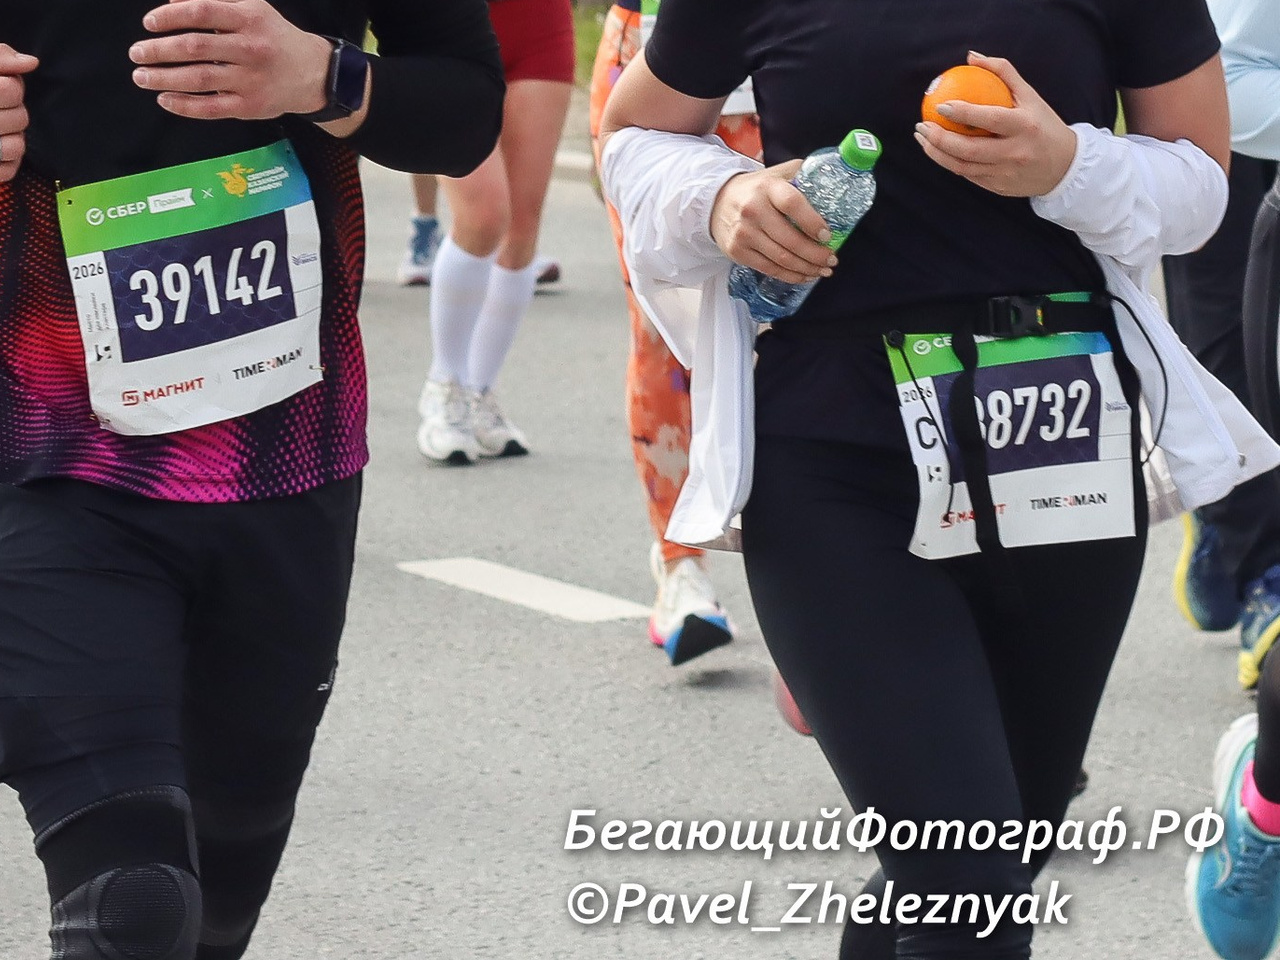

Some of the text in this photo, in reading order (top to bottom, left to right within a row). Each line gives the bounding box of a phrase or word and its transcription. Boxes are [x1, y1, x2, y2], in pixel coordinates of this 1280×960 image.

[107, 200, 148, 219] СБЕР
[72, 262, 104, 280] 2026
[129, 240, 283, 331] 39142
[142, 377, 205, 403] МАГНИТ
[915, 416, 939, 449] C
